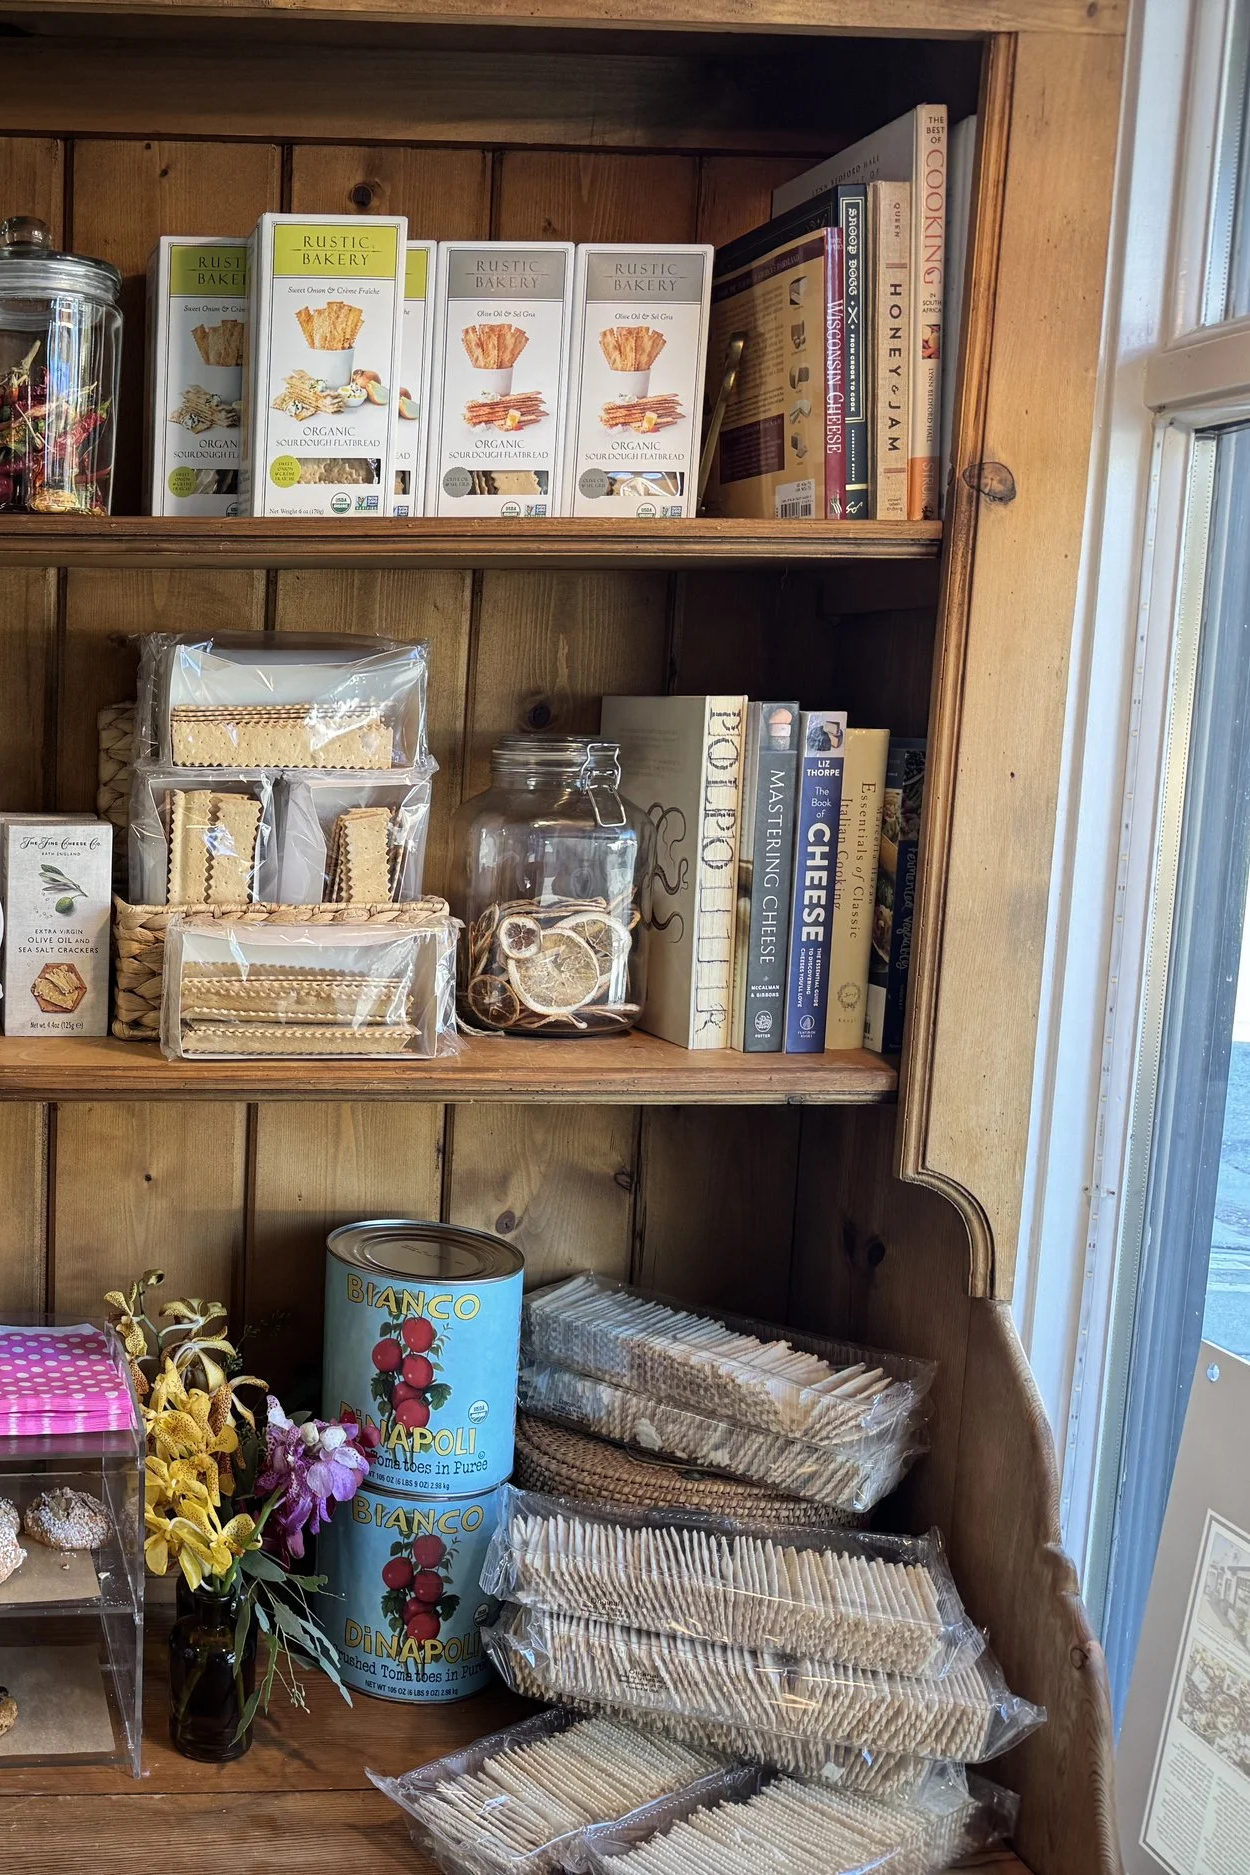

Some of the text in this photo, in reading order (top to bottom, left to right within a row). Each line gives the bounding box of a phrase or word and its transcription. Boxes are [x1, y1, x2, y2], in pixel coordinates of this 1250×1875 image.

[929, 116, 944, 124] THE
[926, 126, 945, 134] BEST
[893, 202, 901, 238] QUEEN
[923, 149, 944, 285] COOKING
[303, 236, 370, 249] RUSTIC
[302, 253, 370, 266] BAKERY
[476, 260, 540, 273] RUSTIC
[615, 263, 679, 276] RUSTIC
[475, 276, 540, 289] BAKERY
[614, 279, 678, 293] BAKERY
[287, 286, 306, 294] Sweet
[336, 287, 357, 295] Crème
[888, 283, 903, 376] HONEY
[826, 300, 844, 454] WISCONSIN CHEESE
[850, 380, 855, 390] TO
[302, 426, 356, 437] ORGANIC
[888, 401, 902, 452] JAM
[275, 439, 381, 447] SOURDOUGH FLATBREAD
[474, 439, 525, 449] ORGANIC
[611, 441, 661, 451] ORGANIC
[448, 450, 549, 459] SOURDOUGH FLATBREAD
[818, 760, 830, 768] LIZ
[806, 768, 840, 778] THORPE
[814, 787, 830, 796] The
[811, 798, 832, 807] Book
[816, 808, 826, 818] of
[838, 798, 854, 844] Italian
[850, 781, 876, 939] Essentials of Classic
[760, 770, 786, 964] MASTERING CHEESE
[802, 822, 832, 942] CHEESE
[57, 936, 72, 944] OIL
[346, 1273, 481, 1320] BIANCO
[352, 1496, 484, 1534] BIANCO
